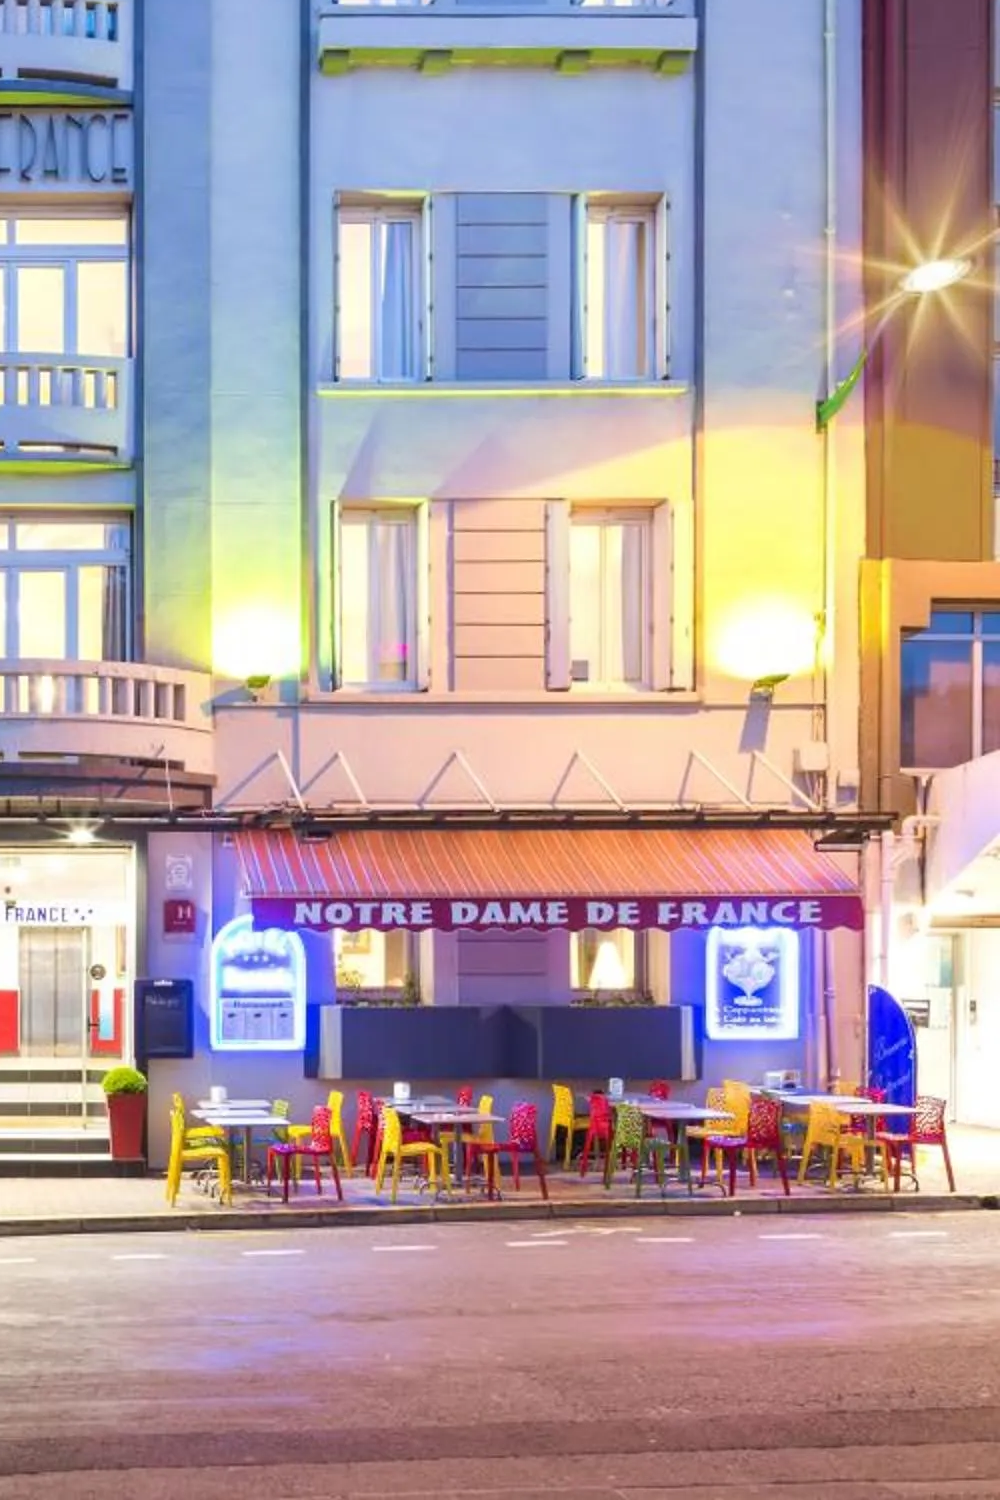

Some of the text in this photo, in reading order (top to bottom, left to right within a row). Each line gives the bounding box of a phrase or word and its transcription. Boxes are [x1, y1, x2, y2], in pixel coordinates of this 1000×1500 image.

[5, 905, 68, 922] FRANCE
[294, 901, 822, 925] NOTRE DAME DE FRANCE
